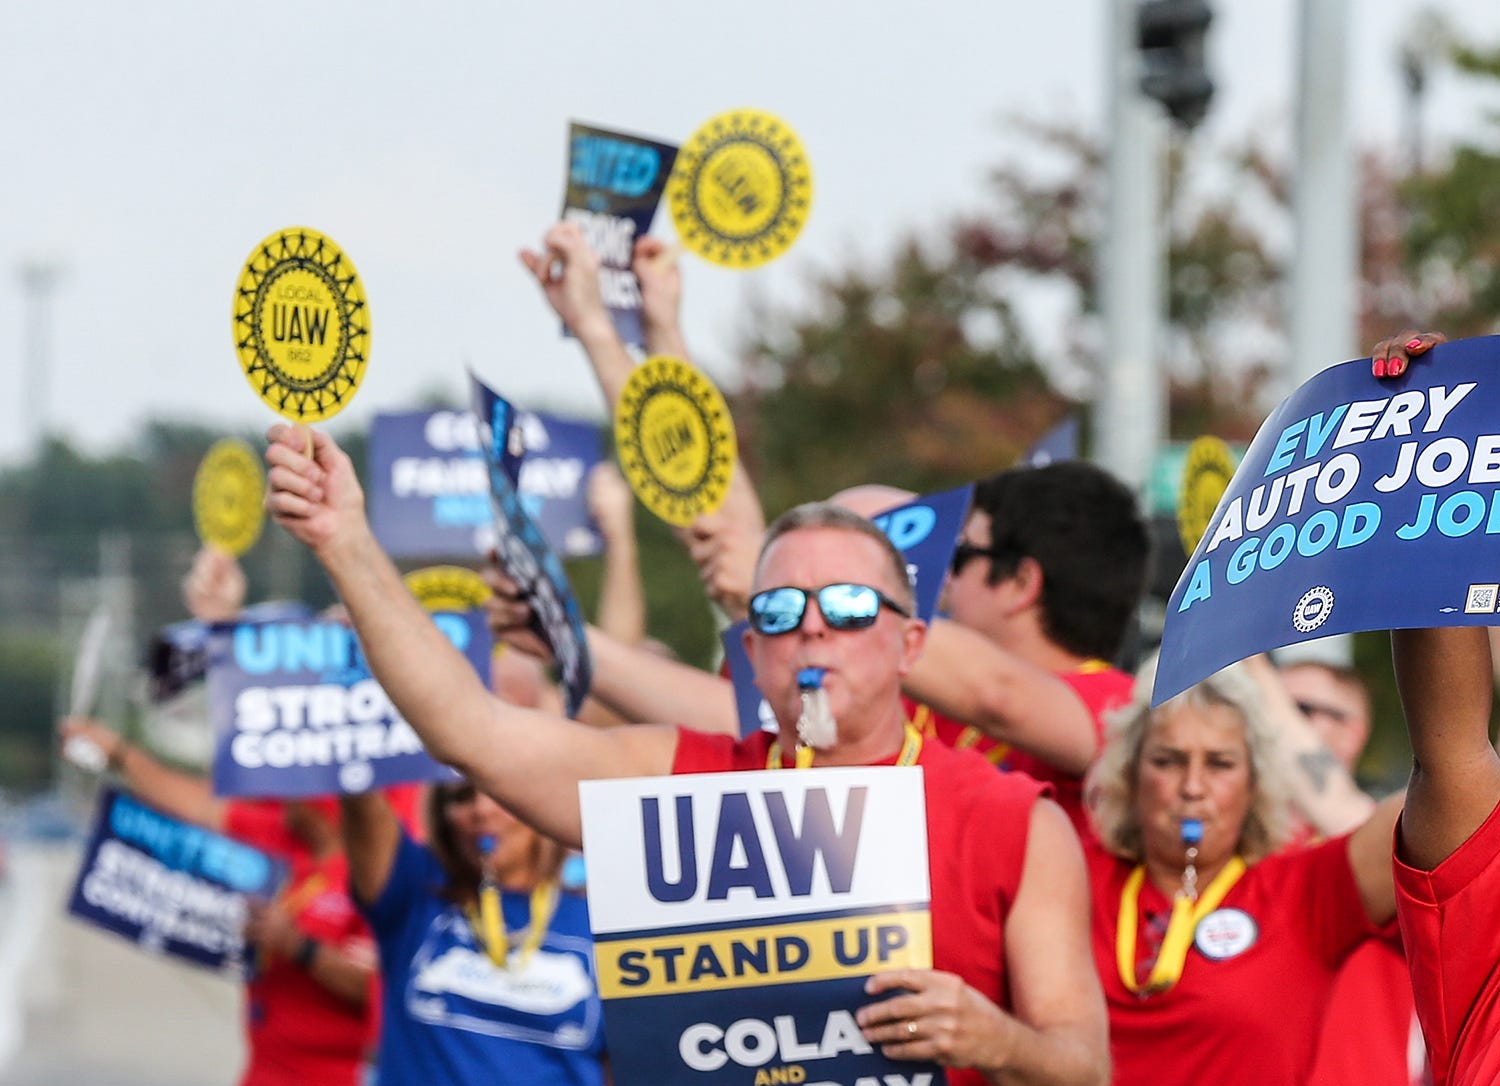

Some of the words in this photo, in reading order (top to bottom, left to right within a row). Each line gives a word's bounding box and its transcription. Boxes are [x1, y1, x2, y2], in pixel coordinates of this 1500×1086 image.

[273, 304, 329, 345] UAW
[277, 286, 322, 304] LOCAL
[1264, 382, 1478, 477] EVERY
[1205, 452, 1361, 553] AUTO
[1177, 560, 1212, 613] A
[1225, 502, 1382, 585] GOOD
[234, 678, 390, 735] STRO
[641, 786, 869, 902] UAW
[616, 935, 810, 987] STAND
[831, 925, 909, 967] UP
[678, 1009, 874, 1072] COLA
